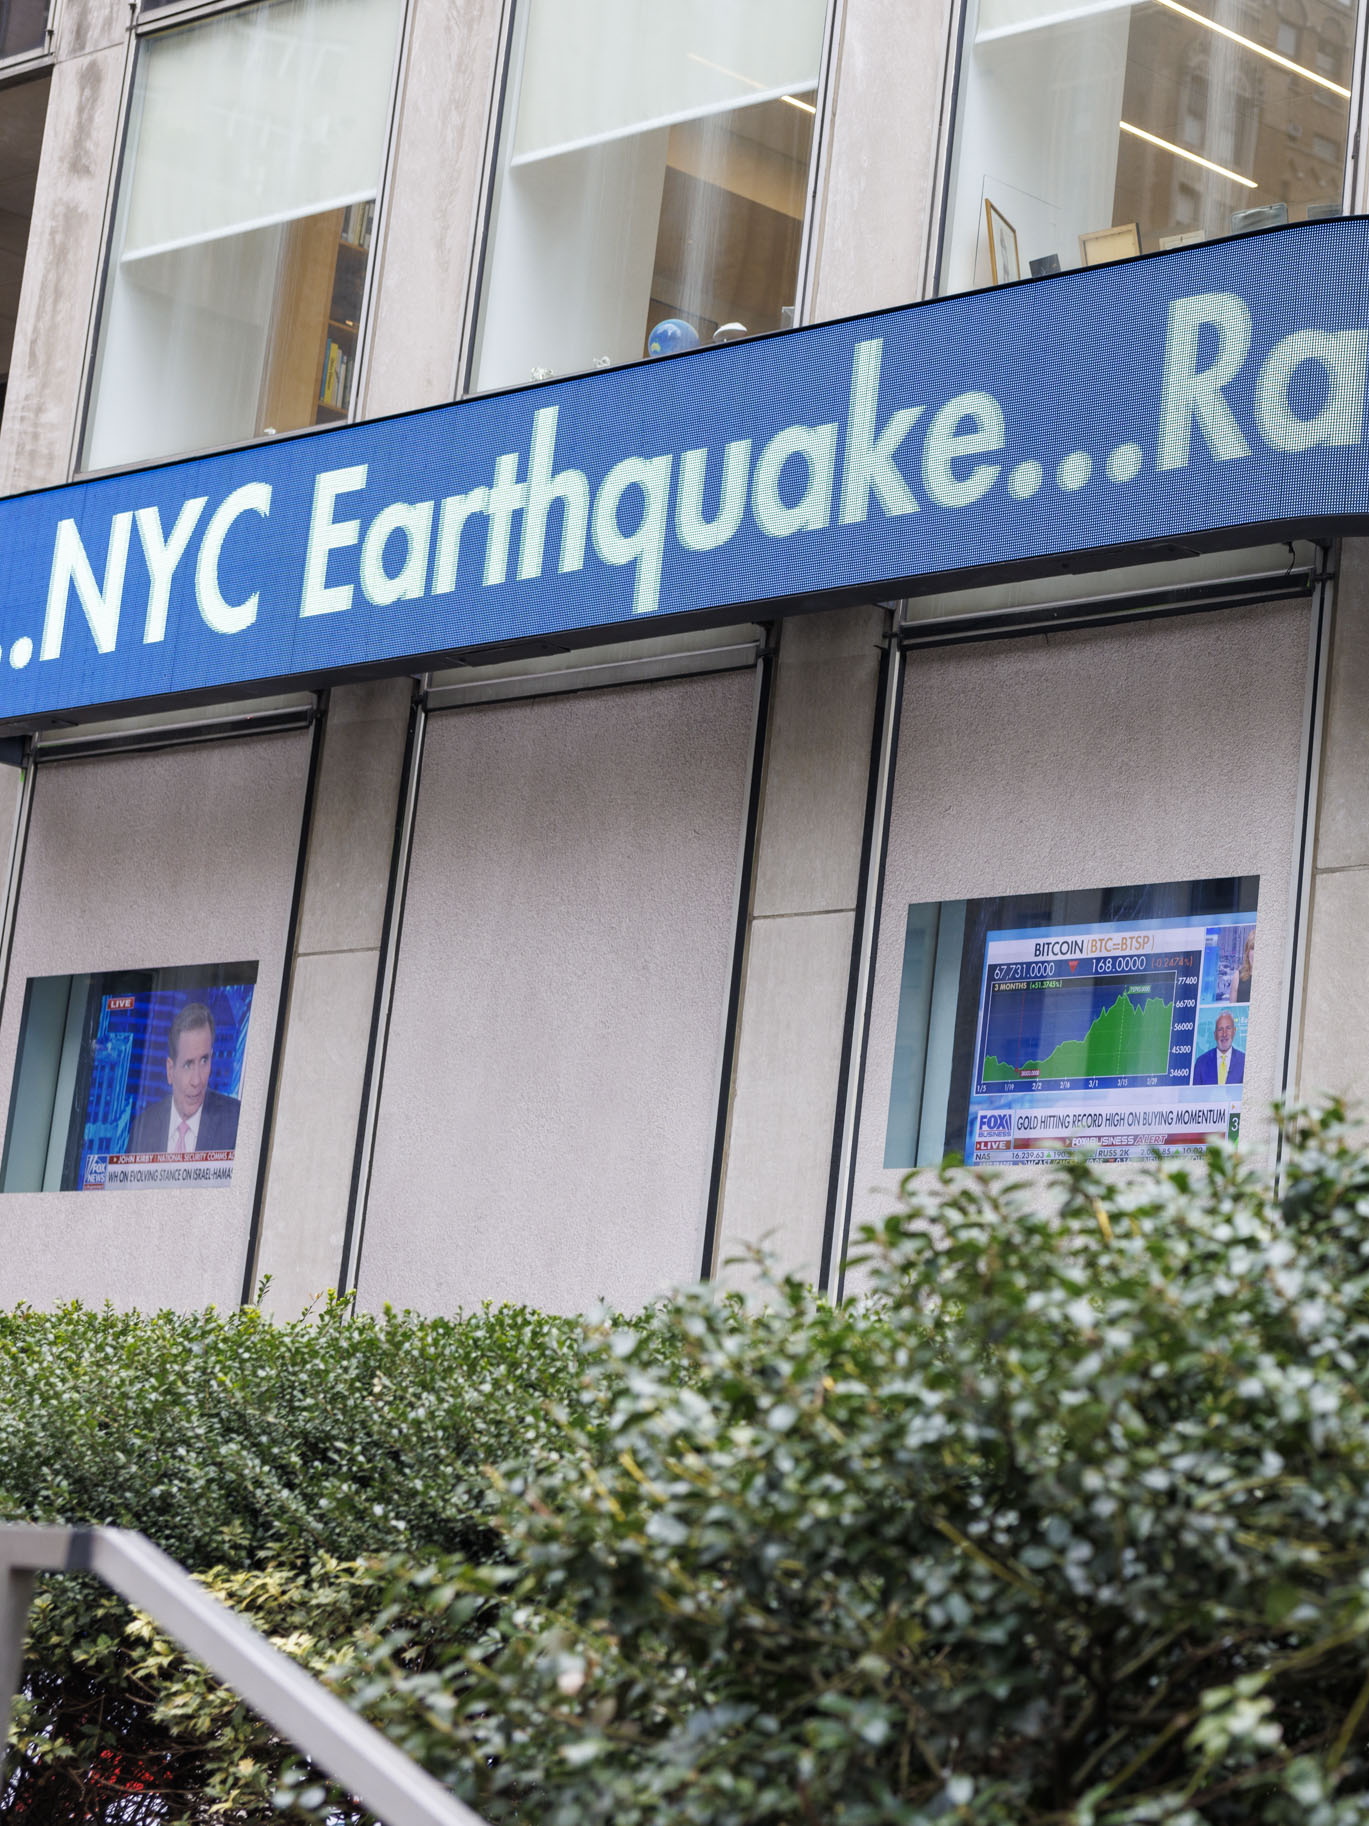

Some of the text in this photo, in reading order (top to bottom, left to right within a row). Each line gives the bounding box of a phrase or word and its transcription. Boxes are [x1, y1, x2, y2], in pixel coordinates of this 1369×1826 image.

[1034, 935, 1155, 957] BITCOIN (BTC=BTSP)
[994, 963, 1055, 980] 67,731.0000
[1092, 956, 1146, 973] 168.0000
[1178, 976, 1197, 984] 77400
[994, 983, 999, 991] 3
[1000, 982, 1027, 991] MONTHS
[110, 1000, 131, 1009] LIVE
[1176, 1000, 1196, 1008] 66700
[1174, 1022, 1194, 1031] 56000
[1171, 1045, 1192, 1054] 45300
[1169, 1068, 1190, 1077] 34600
[976, 1085, 987, 1093] 1/5
[1031, 1082, 1042, 1090] 2/2
[1088, 1080, 1099, 1088] 3/1
[979, 1113, 1006, 1130] FOX
[1016, 1108, 1226, 1131] GOLD HITTING RECORD HIGH ON BUYING MOMENTUM
[1134, 1134, 1168, 1145] ALERT
[980, 1141, 1007, 1150] LIVE
[975, 1153, 991, 1161] NAS
[1098, 1149, 1118, 1157] RUSS
[1120, 1148, 1130, 1157] 2K
[93, 1163, 106, 1173] FOX
[86, 1174, 106, 1183] NEWS
[108, 1171, 118, 1184] WH
[119, 1170, 129, 1183] ON
[129, 1169, 159, 1183] EVOLVING
[159, 1168, 181, 1182] STANCE
[182, 1168, 193, 1181] ON
